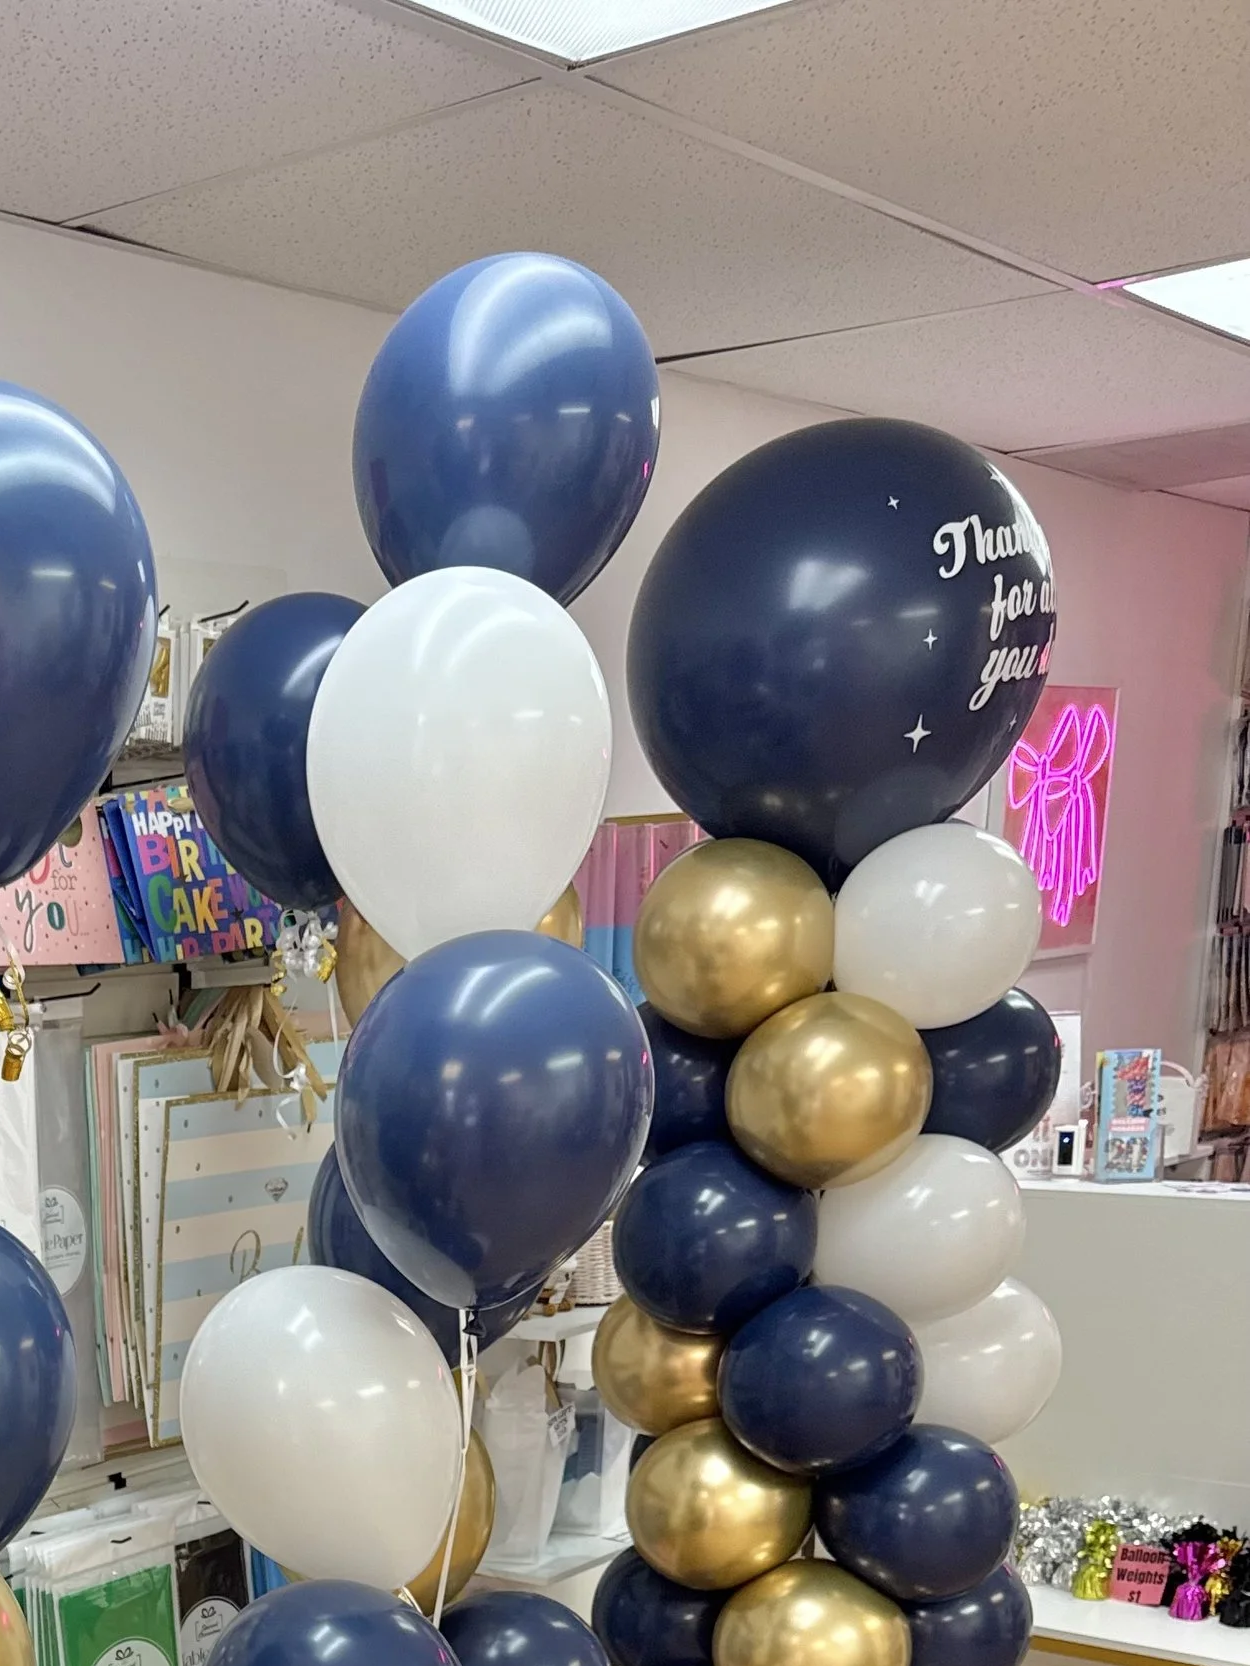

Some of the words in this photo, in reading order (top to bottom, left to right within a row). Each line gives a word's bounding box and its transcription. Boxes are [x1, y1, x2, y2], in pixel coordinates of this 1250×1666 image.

[990, 574, 1038, 642] for
[969, 644, 1039, 711] you
[132, 810, 194, 840] HAPPY
[50, 869, 78, 890] for
[148, 873, 229, 934] CAKE
[53, 1233, 83, 1250] Paper
[1120, 1547, 1165, 1564] Balloon
[1117, 1567, 1164, 1585] Weights
